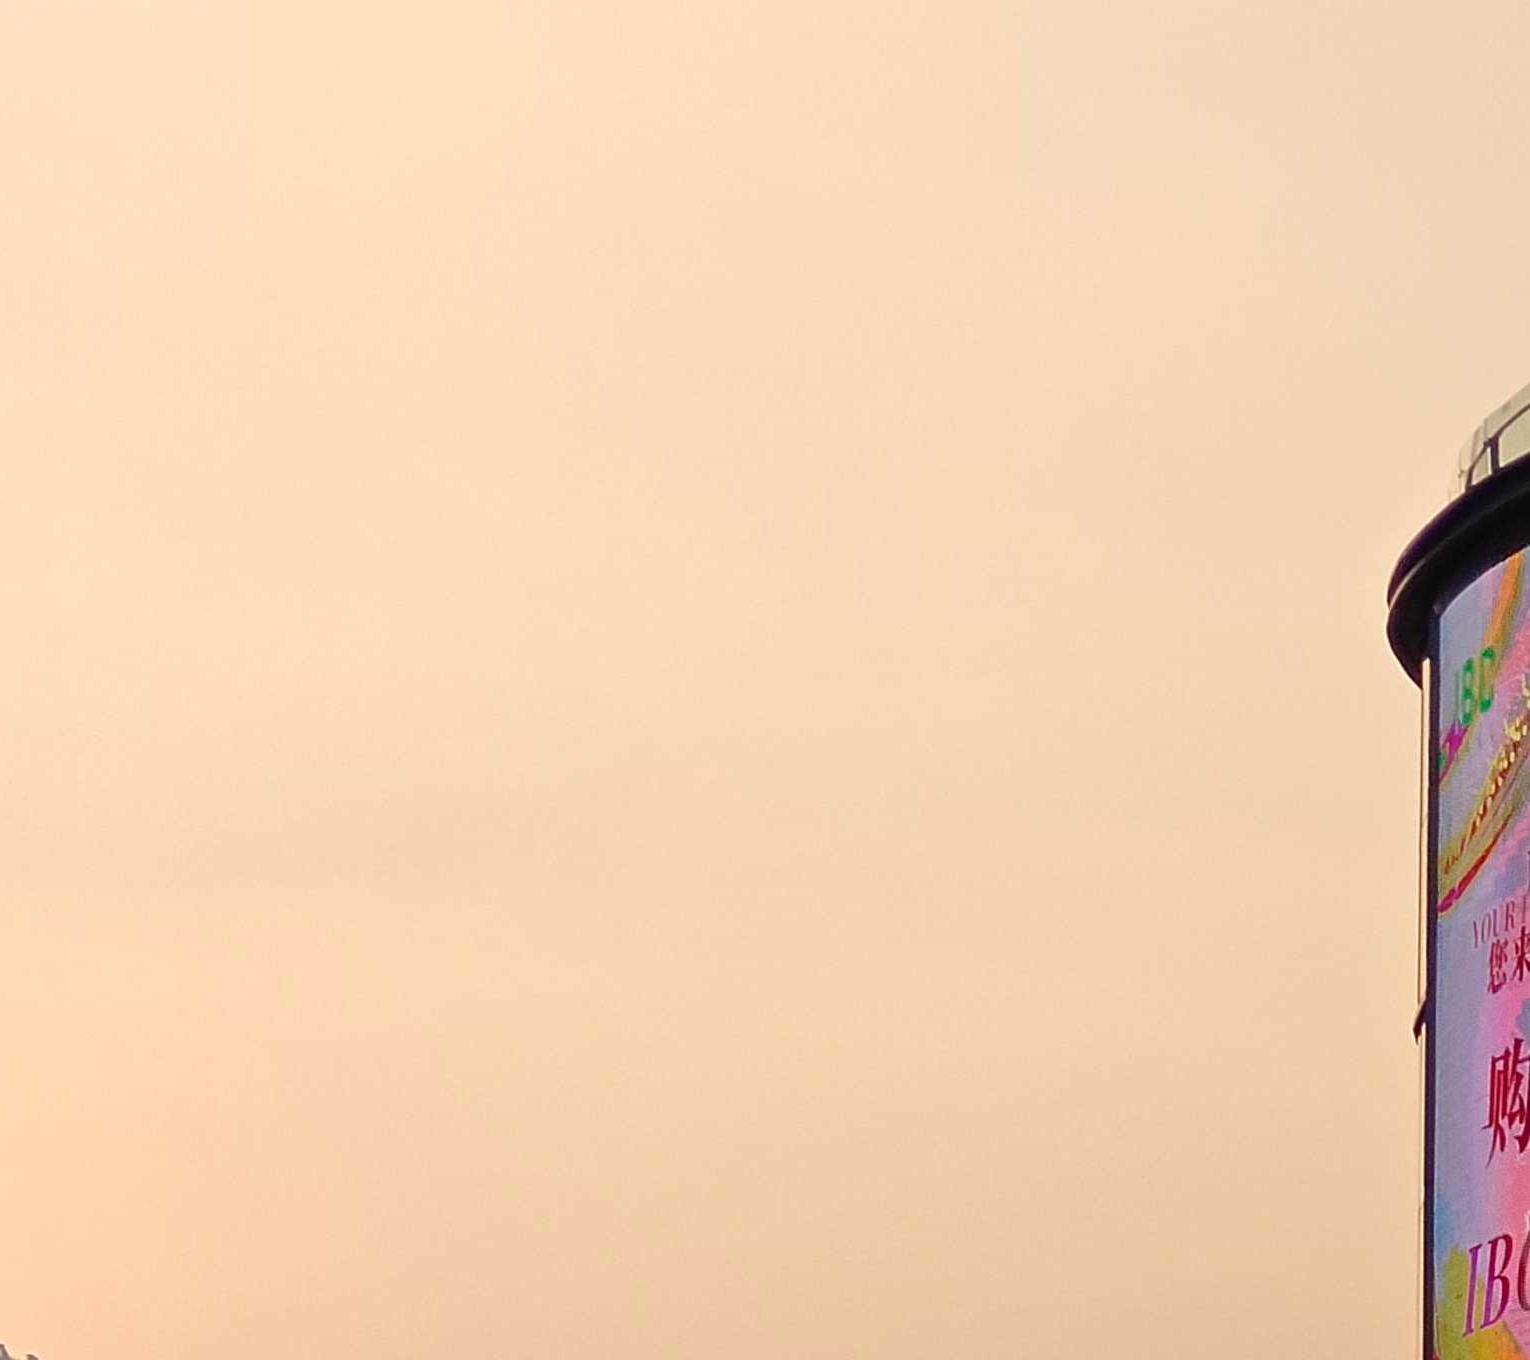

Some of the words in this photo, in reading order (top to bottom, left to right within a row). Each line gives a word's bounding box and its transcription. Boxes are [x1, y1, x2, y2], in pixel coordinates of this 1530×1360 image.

[1472, 900, 1516, 949] YOUR
[1488, 926, 1530, 994] 您来
[1481, 1037, 1530, 1168] 购
